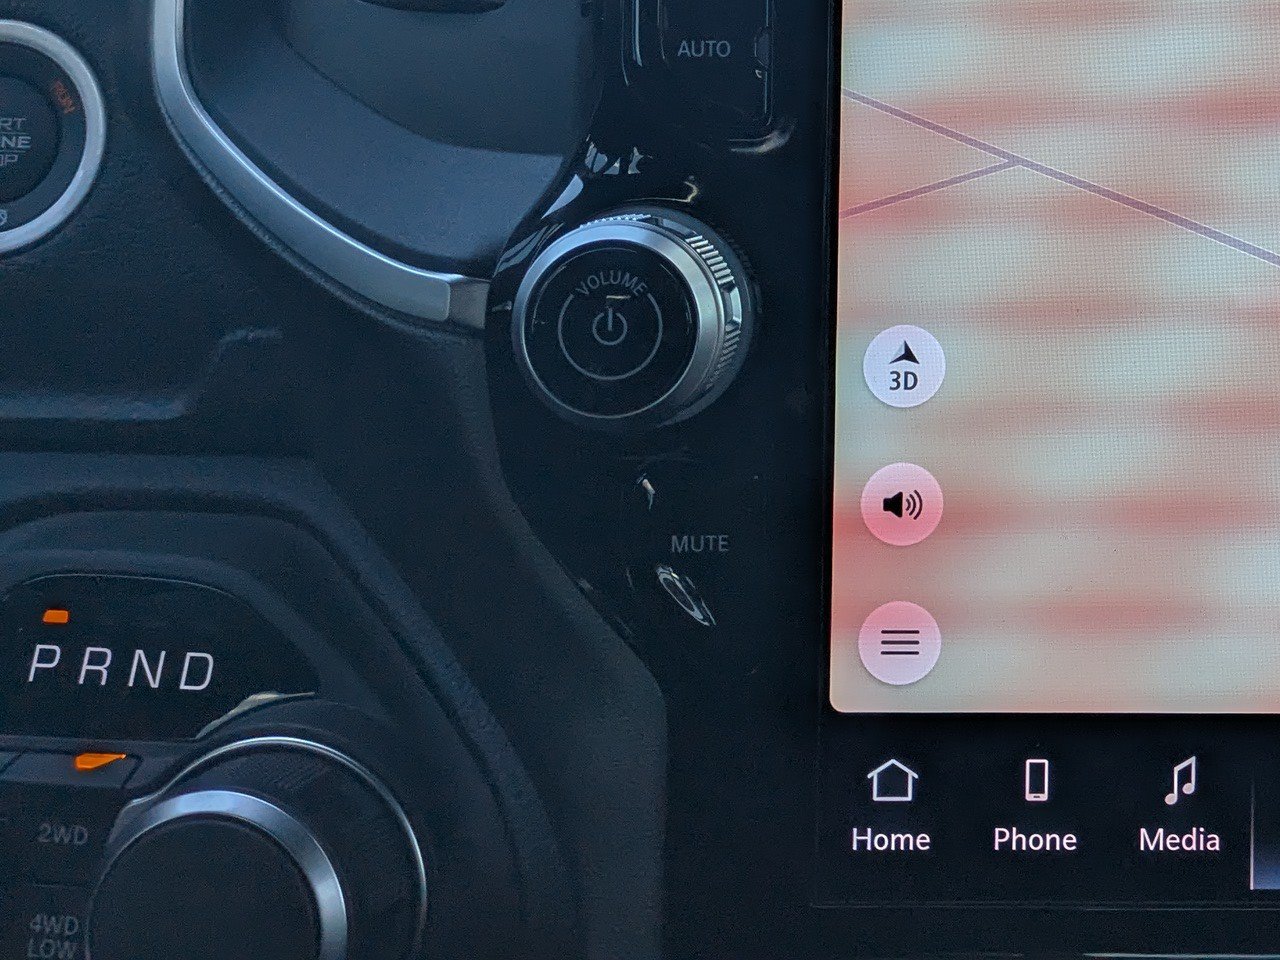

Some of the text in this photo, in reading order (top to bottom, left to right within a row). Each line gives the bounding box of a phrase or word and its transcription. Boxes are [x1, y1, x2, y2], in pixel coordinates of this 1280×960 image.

[677, 40, 732, 58] AUTO
[574, 270, 648, 298] VOLUME
[889, 371, 919, 391] 3D
[671, 535, 729, 552] MUTE
[37, 823, 88, 845] 2WD
[852, 827, 930, 851] Home
[994, 827, 1077, 851] Phone
[1140, 827, 1221, 851] Media
[30, 913, 79, 936] 4WD
